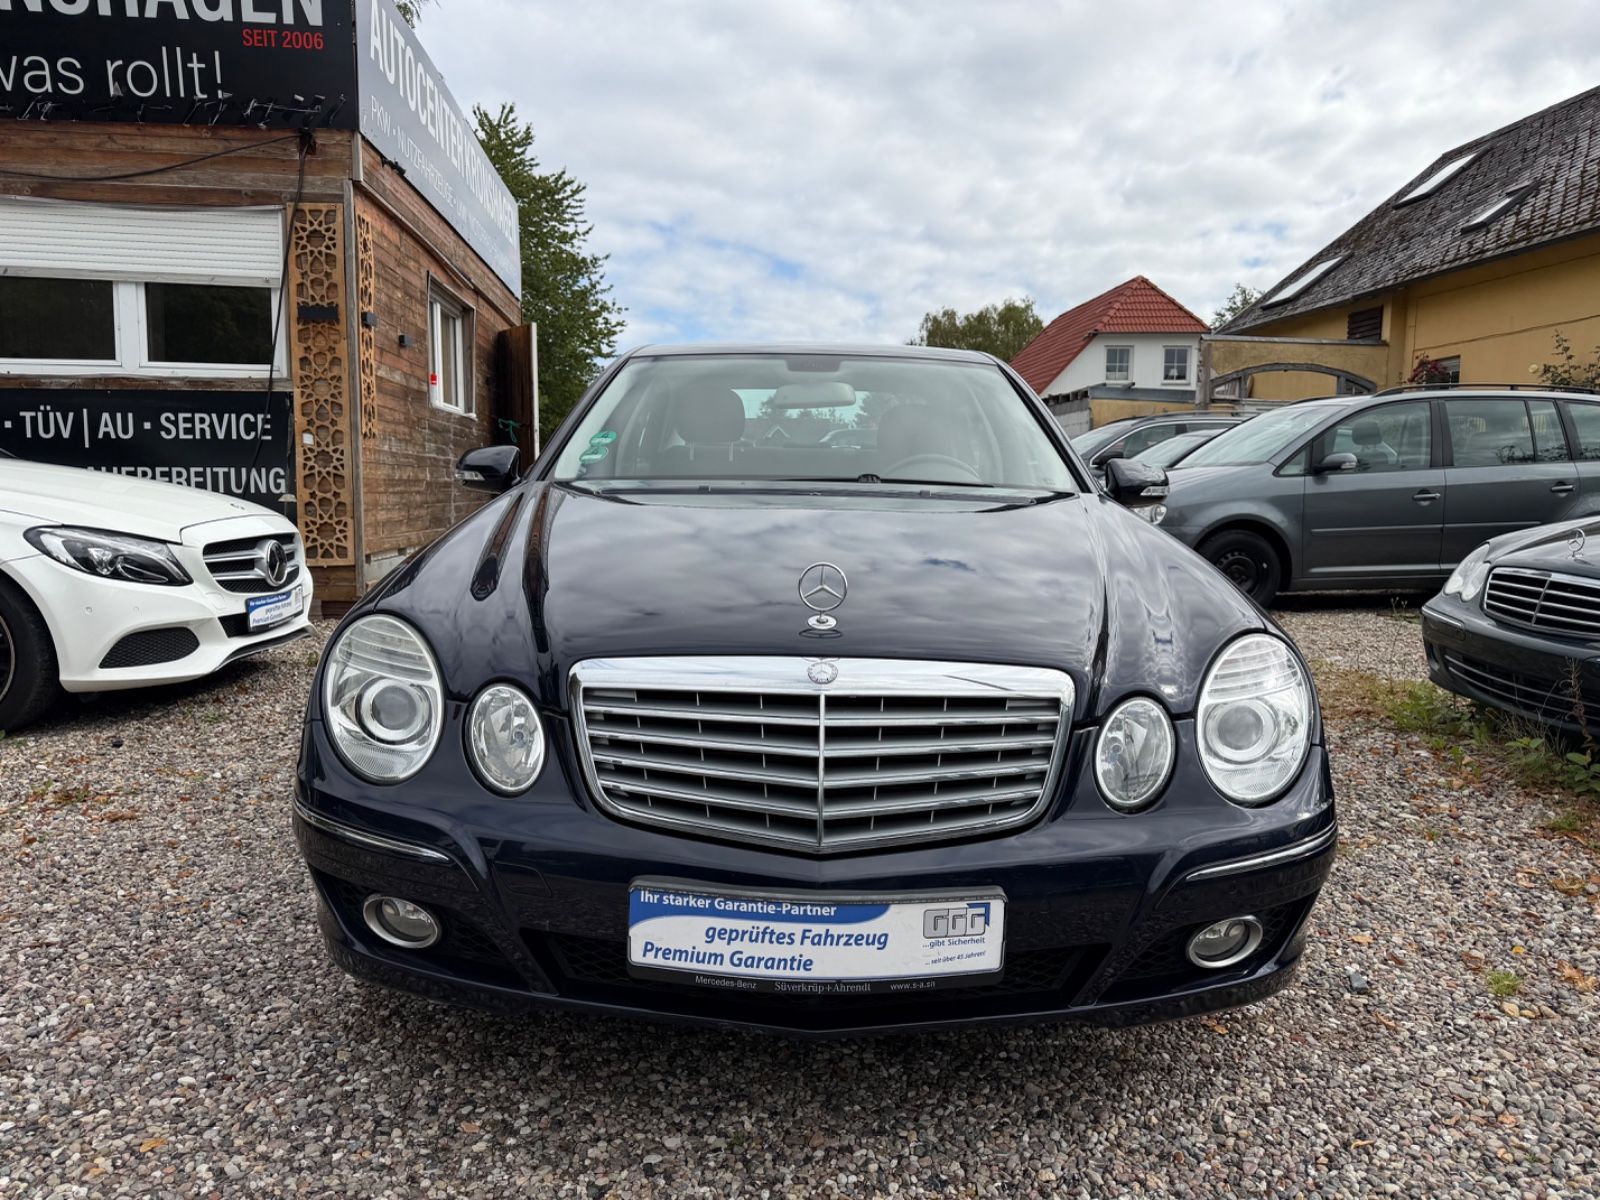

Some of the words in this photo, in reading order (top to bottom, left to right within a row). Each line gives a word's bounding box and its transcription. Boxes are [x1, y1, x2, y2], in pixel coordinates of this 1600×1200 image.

[242, 28, 278, 47] SEIT
[281, 31, 324, 49] 2006
[106, 46, 224, 99] rollt!
[371, 95, 391, 137] PKW
[19, 405, 74, 439] TÜV
[98, 412, 134, 439] AU
[160, 412, 272, 441] SERVICE
[640, 890, 659, 904] Ihr
[662, 893, 711, 909] starker
[714, 897, 837, 916] Garantie-Partner
[705, 926, 795, 946] geprüftes
[800, 928, 889, 950] Fahrzeug
[948, 937, 986, 946] Sicherheit
[642, 941, 724, 966] Premium
[729, 950, 814, 971] Garantie
[695, 975, 757, 989] Mercedes-Benz
